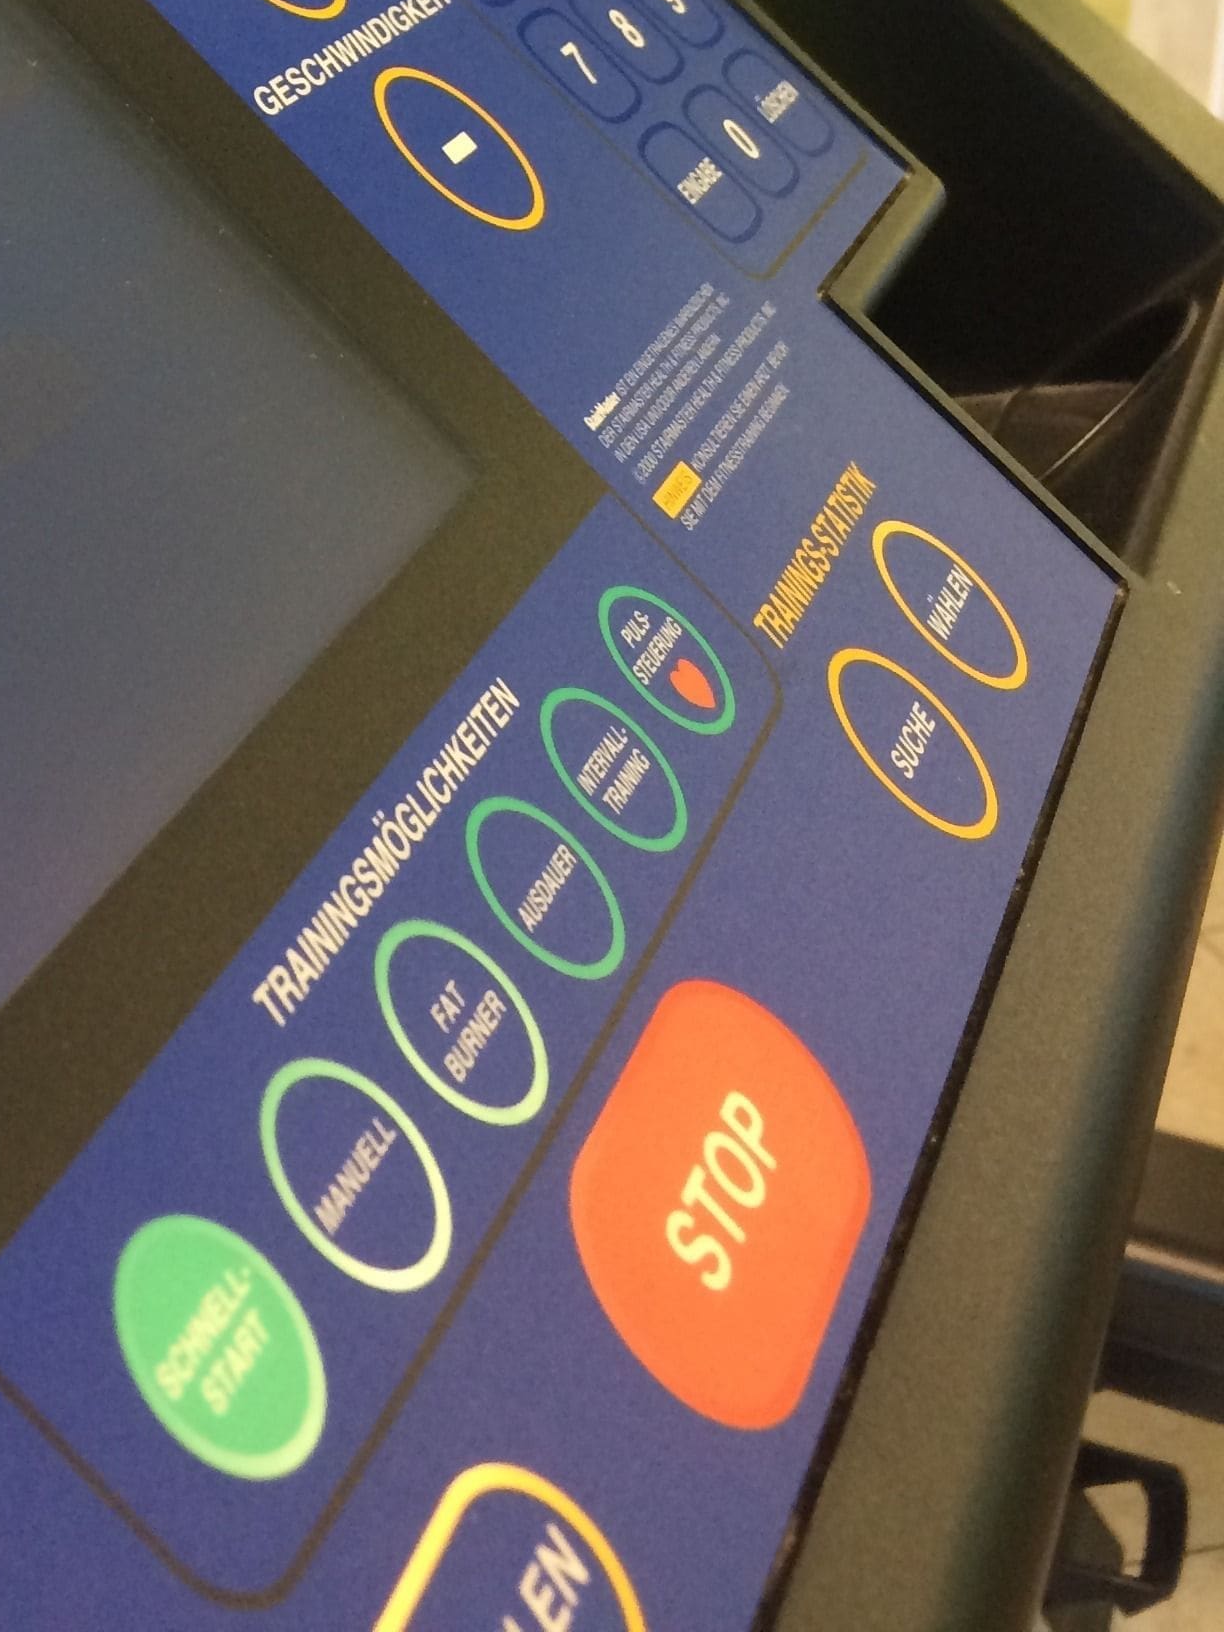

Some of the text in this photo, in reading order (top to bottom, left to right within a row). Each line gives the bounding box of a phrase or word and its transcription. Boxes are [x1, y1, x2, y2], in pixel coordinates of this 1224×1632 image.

[560, 41, 598, 85] 7
[608, 8, 646, 49] 8
[723, 119, 760, 160] 0
[598, 426, 618, 448] DER
[611, 383, 654, 433] STAIRMASTER
[620, 433, 639, 455] DEN
[633, 420, 651, 440] USA
[651, 402, 698, 459] STAIRMASTER
[753, 460, 877, 649] TRAININGS-STATISTIK
[927, 564, 974, 641] WÄHLEN
[632, 616, 683, 685] STEUERUNG
[576, 725, 629, 797] INTERVALL-
[889, 701, 936, 779] SUCHE
[602, 748, 652, 815] TRAINING
[252, 676, 521, 1028] TRAININGSMÖGLICHKEITEN
[516, 843, 579, 934] AUSDAUER
[430, 979, 466, 1034] FAT
[443, 1009, 508, 1083] BURNER
[314, 1116, 397, 1236] MANUELL
[664, 1090, 779, 1291] STOP
[200, 1308, 270, 1415] START
